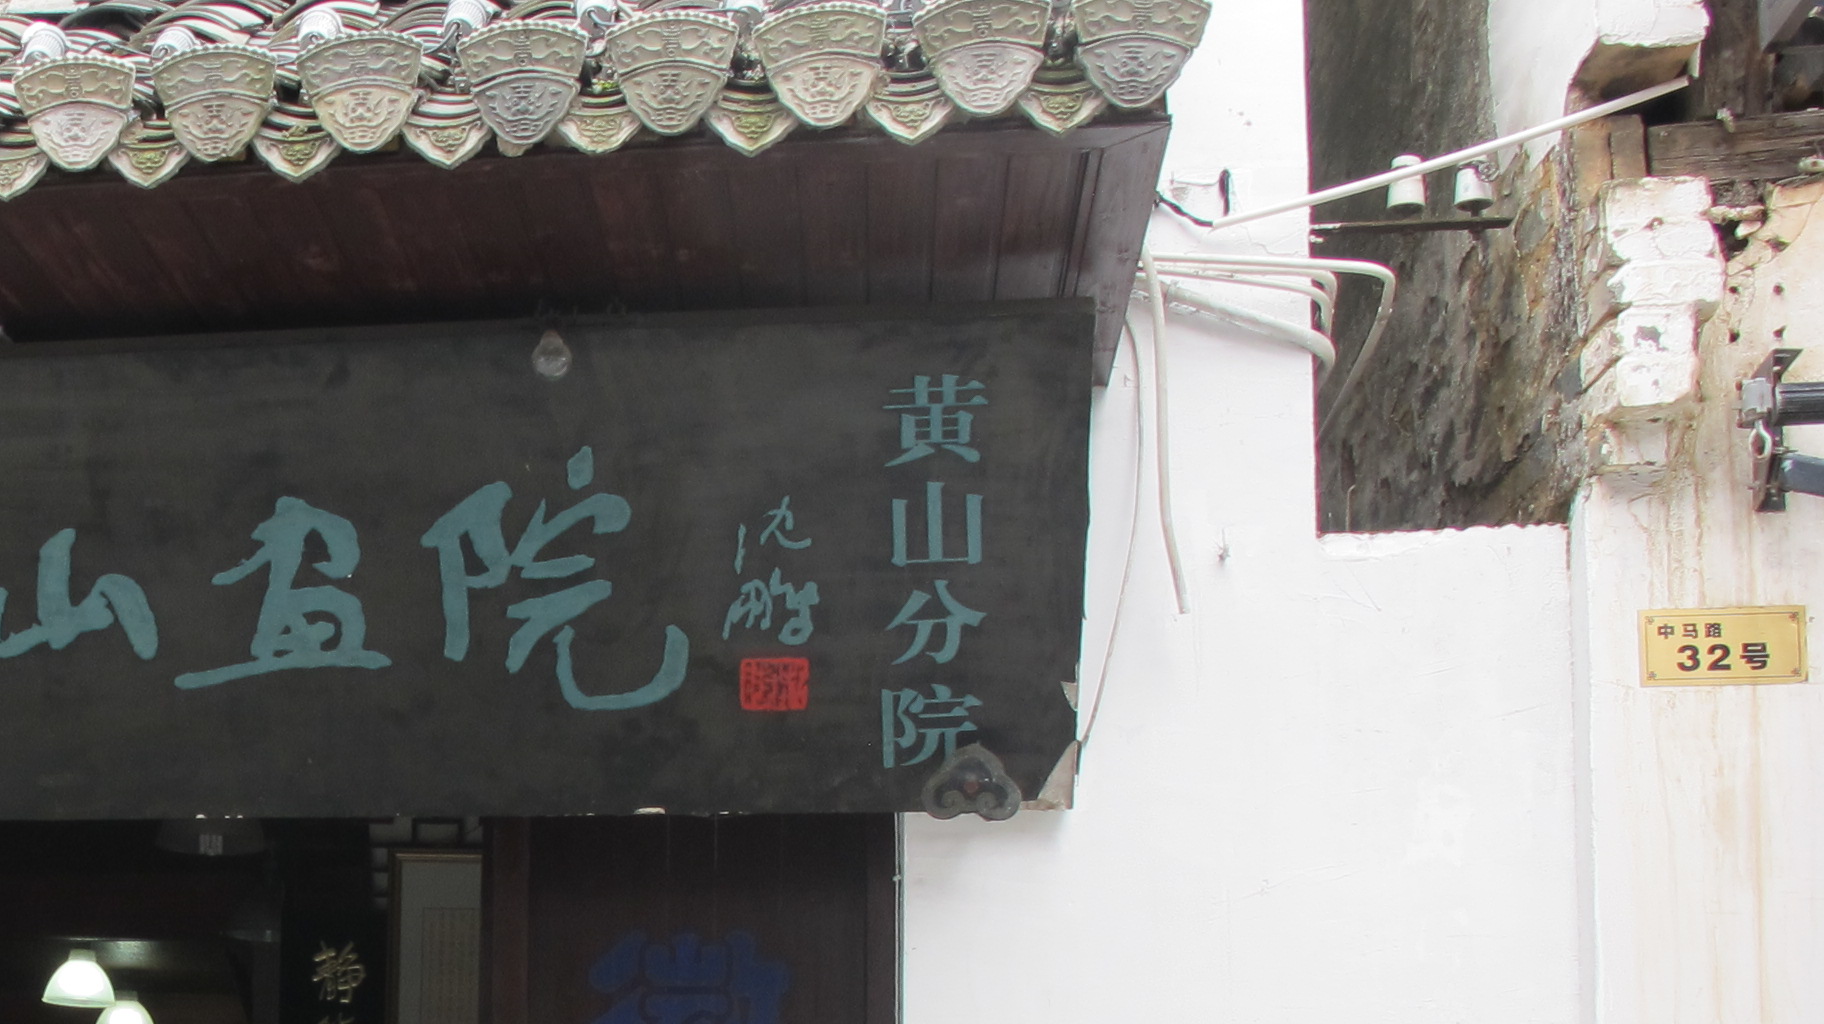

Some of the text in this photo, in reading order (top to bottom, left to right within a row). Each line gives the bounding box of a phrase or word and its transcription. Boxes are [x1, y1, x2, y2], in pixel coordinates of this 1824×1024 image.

[881, 373, 990, 770] 黄山分院
[1657, 622, 1722, 639] 中马路
[1677, 642, 1770, 672] 32号
